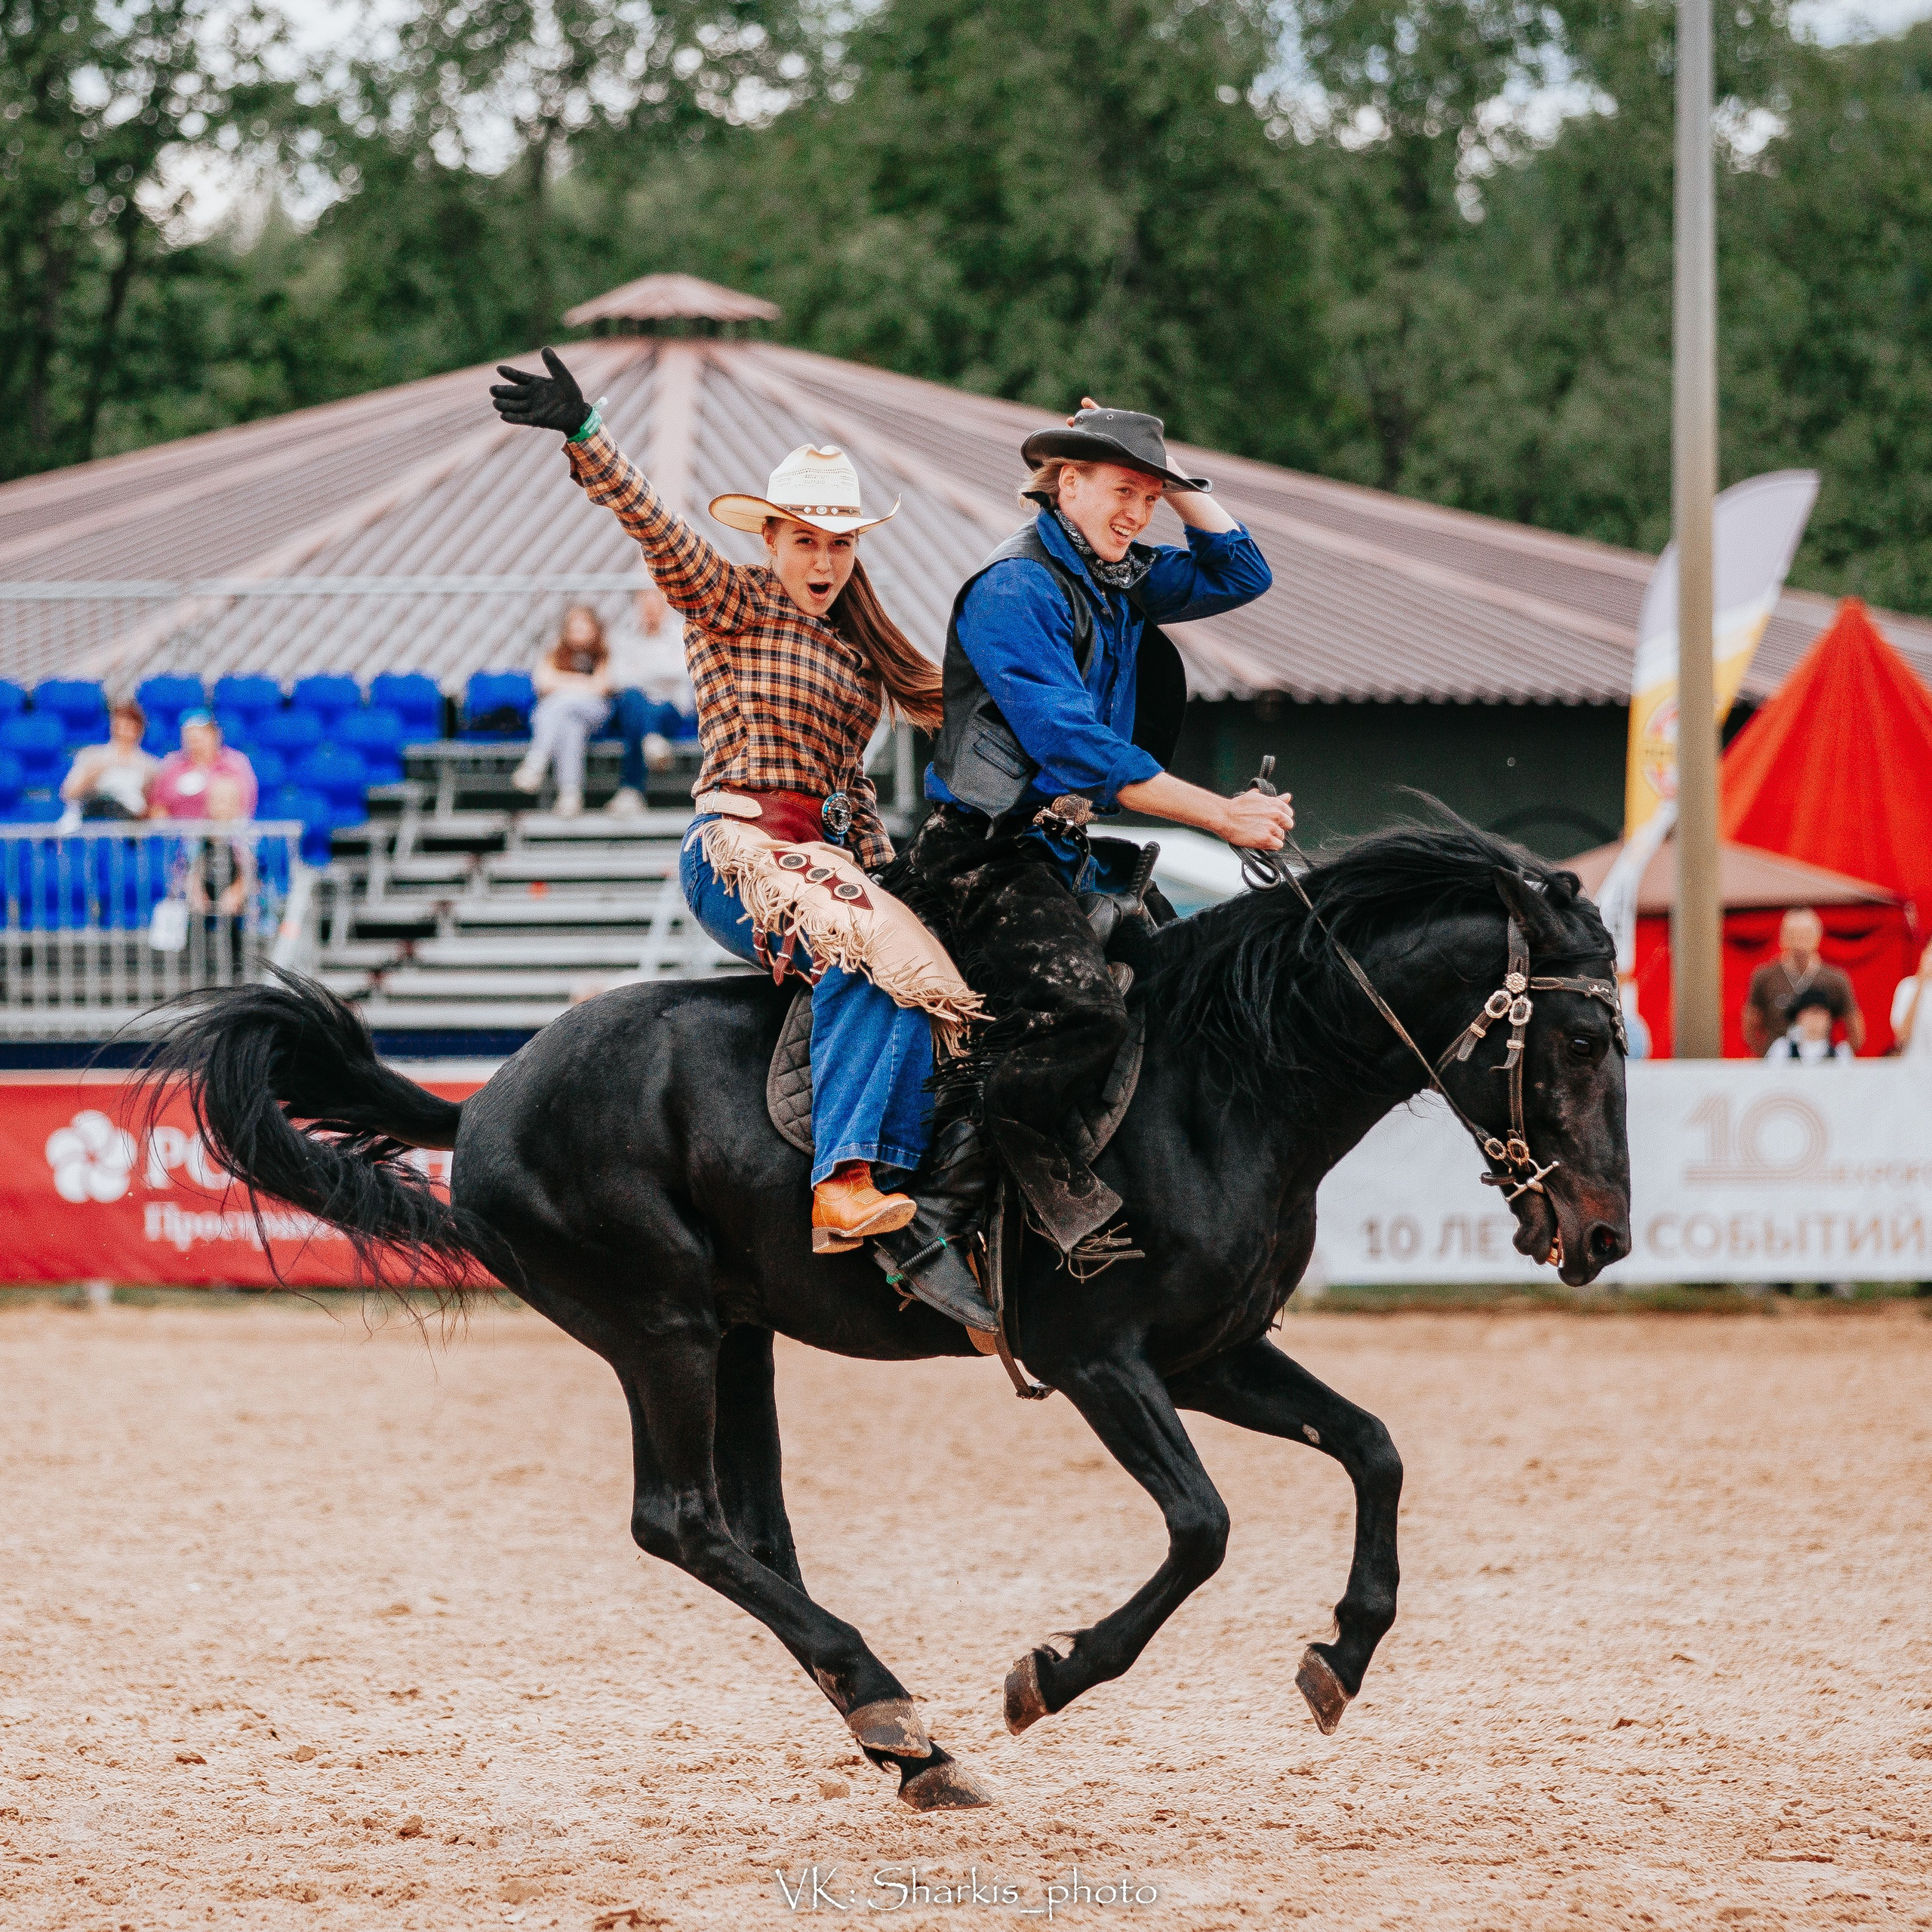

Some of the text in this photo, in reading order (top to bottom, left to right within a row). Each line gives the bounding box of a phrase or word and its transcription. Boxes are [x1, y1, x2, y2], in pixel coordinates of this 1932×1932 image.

[1683, 1089, 1832, 1185] 10
[1361, 1201, 1926, 1262] 10 ЛЕ СОБЫТИЙ
